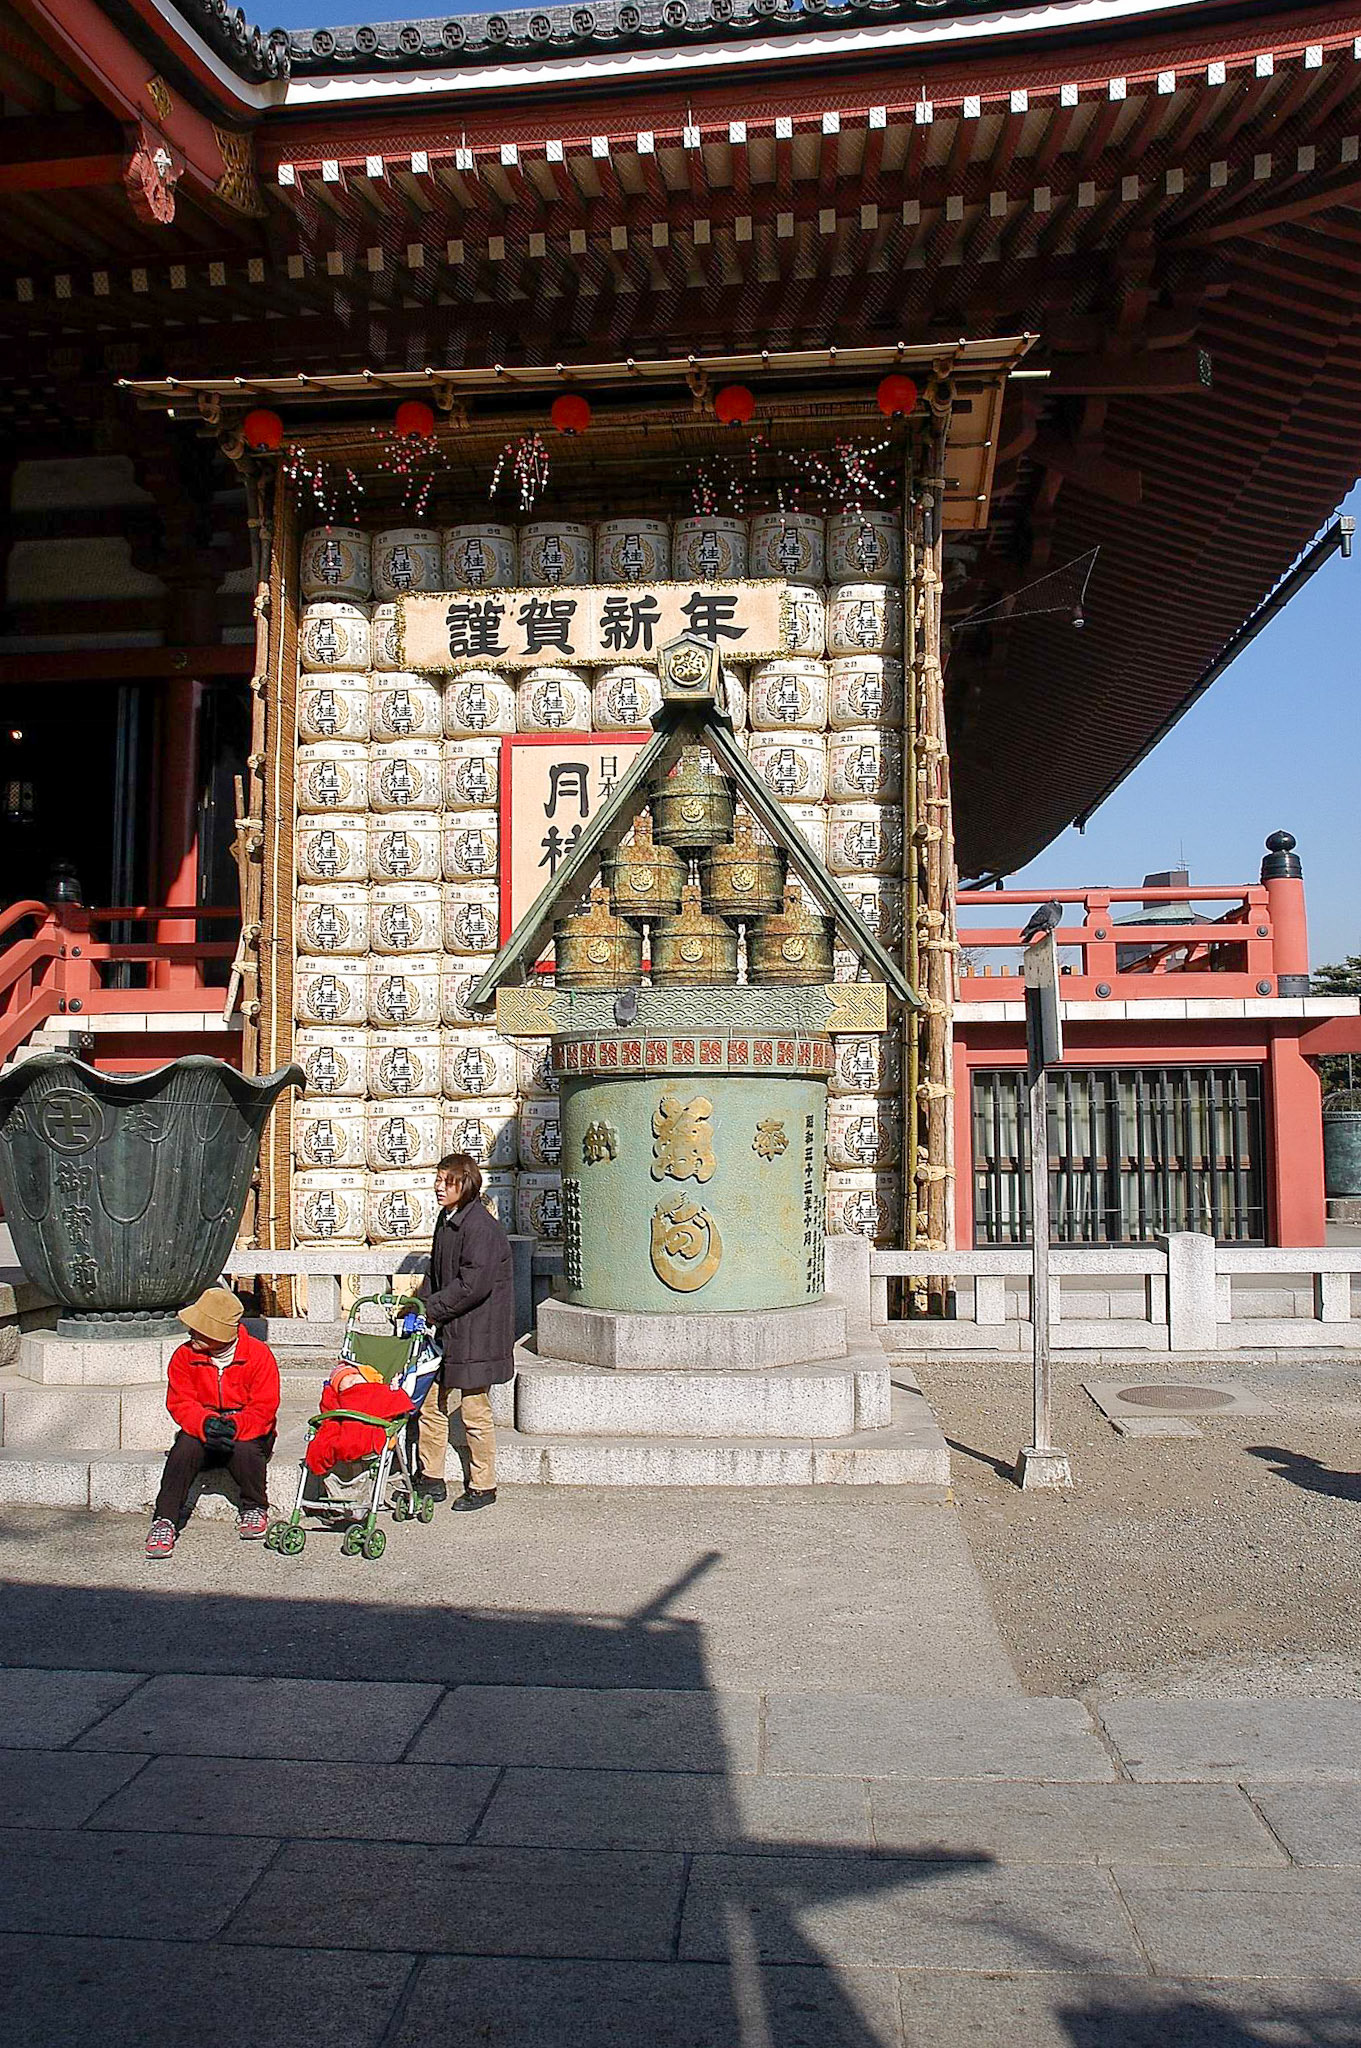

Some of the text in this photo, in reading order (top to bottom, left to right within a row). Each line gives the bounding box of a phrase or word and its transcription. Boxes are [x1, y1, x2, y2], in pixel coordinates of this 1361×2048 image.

[391, 547, 412, 589] 月桂冠
[464, 539, 485, 584] 月桂冠
[542, 537, 563, 582] 月桂冠
[622, 535, 644, 580] 月桂冠
[699, 532, 719, 579] 月桂冠
[779, 528, 801, 574] 月桂冠
[316, 619, 337, 663] 月桂冠
[446, 592, 749, 660] 謹賀新年
[856, 602, 878, 647] 月桂冠
[317, 690, 337, 734] 月桂冠
[391, 690, 412, 734] 月桂冠
[466, 683, 487, 729] 月桂冠
[543, 682, 564, 728] 月桂冠
[618, 678, 638, 724] 月桂冠
[778, 676, 800, 722] 月桂冠
[860, 673, 882, 719] 月桂冠
[319, 762, 339, 805] 月桂冠
[391, 759, 410, 804] 月桂冠
[467, 758, 487, 805] 月桂冠
[776, 749, 798, 795] 月桂冠
[856, 746, 878, 792] 月桂冠
[317, 831, 337, 876] 月桂冠
[389, 831, 410, 876] 月桂冠
[464, 830, 485, 874] 月桂冠
[855, 822, 879, 868] 月桂冠
[317, 904, 338, 949] 月桂冠
[390, 904, 410, 948] 月桂冠
[464, 903, 485, 949] 月桂冠
[317, 976, 338, 1020] 月桂冠
[387, 976, 408, 1021] 月桂冠
[315, 1046, 336, 1092] 月桂冠
[390, 1048, 411, 1092] 月桂冠
[463, 1048, 485, 1092] 月桂冠
[851, 1045, 875, 1089] 月桂冠
[313, 1119, 336, 1164] 月桂冠
[387, 1118, 409, 1164] 月桂冠
[856, 1117, 878, 1164] 月桂冠
[315, 1191, 337, 1236] 月桂冠
[388, 1191, 411, 1236] 月桂冠
[856, 1190, 878, 1237] 月桂冠
